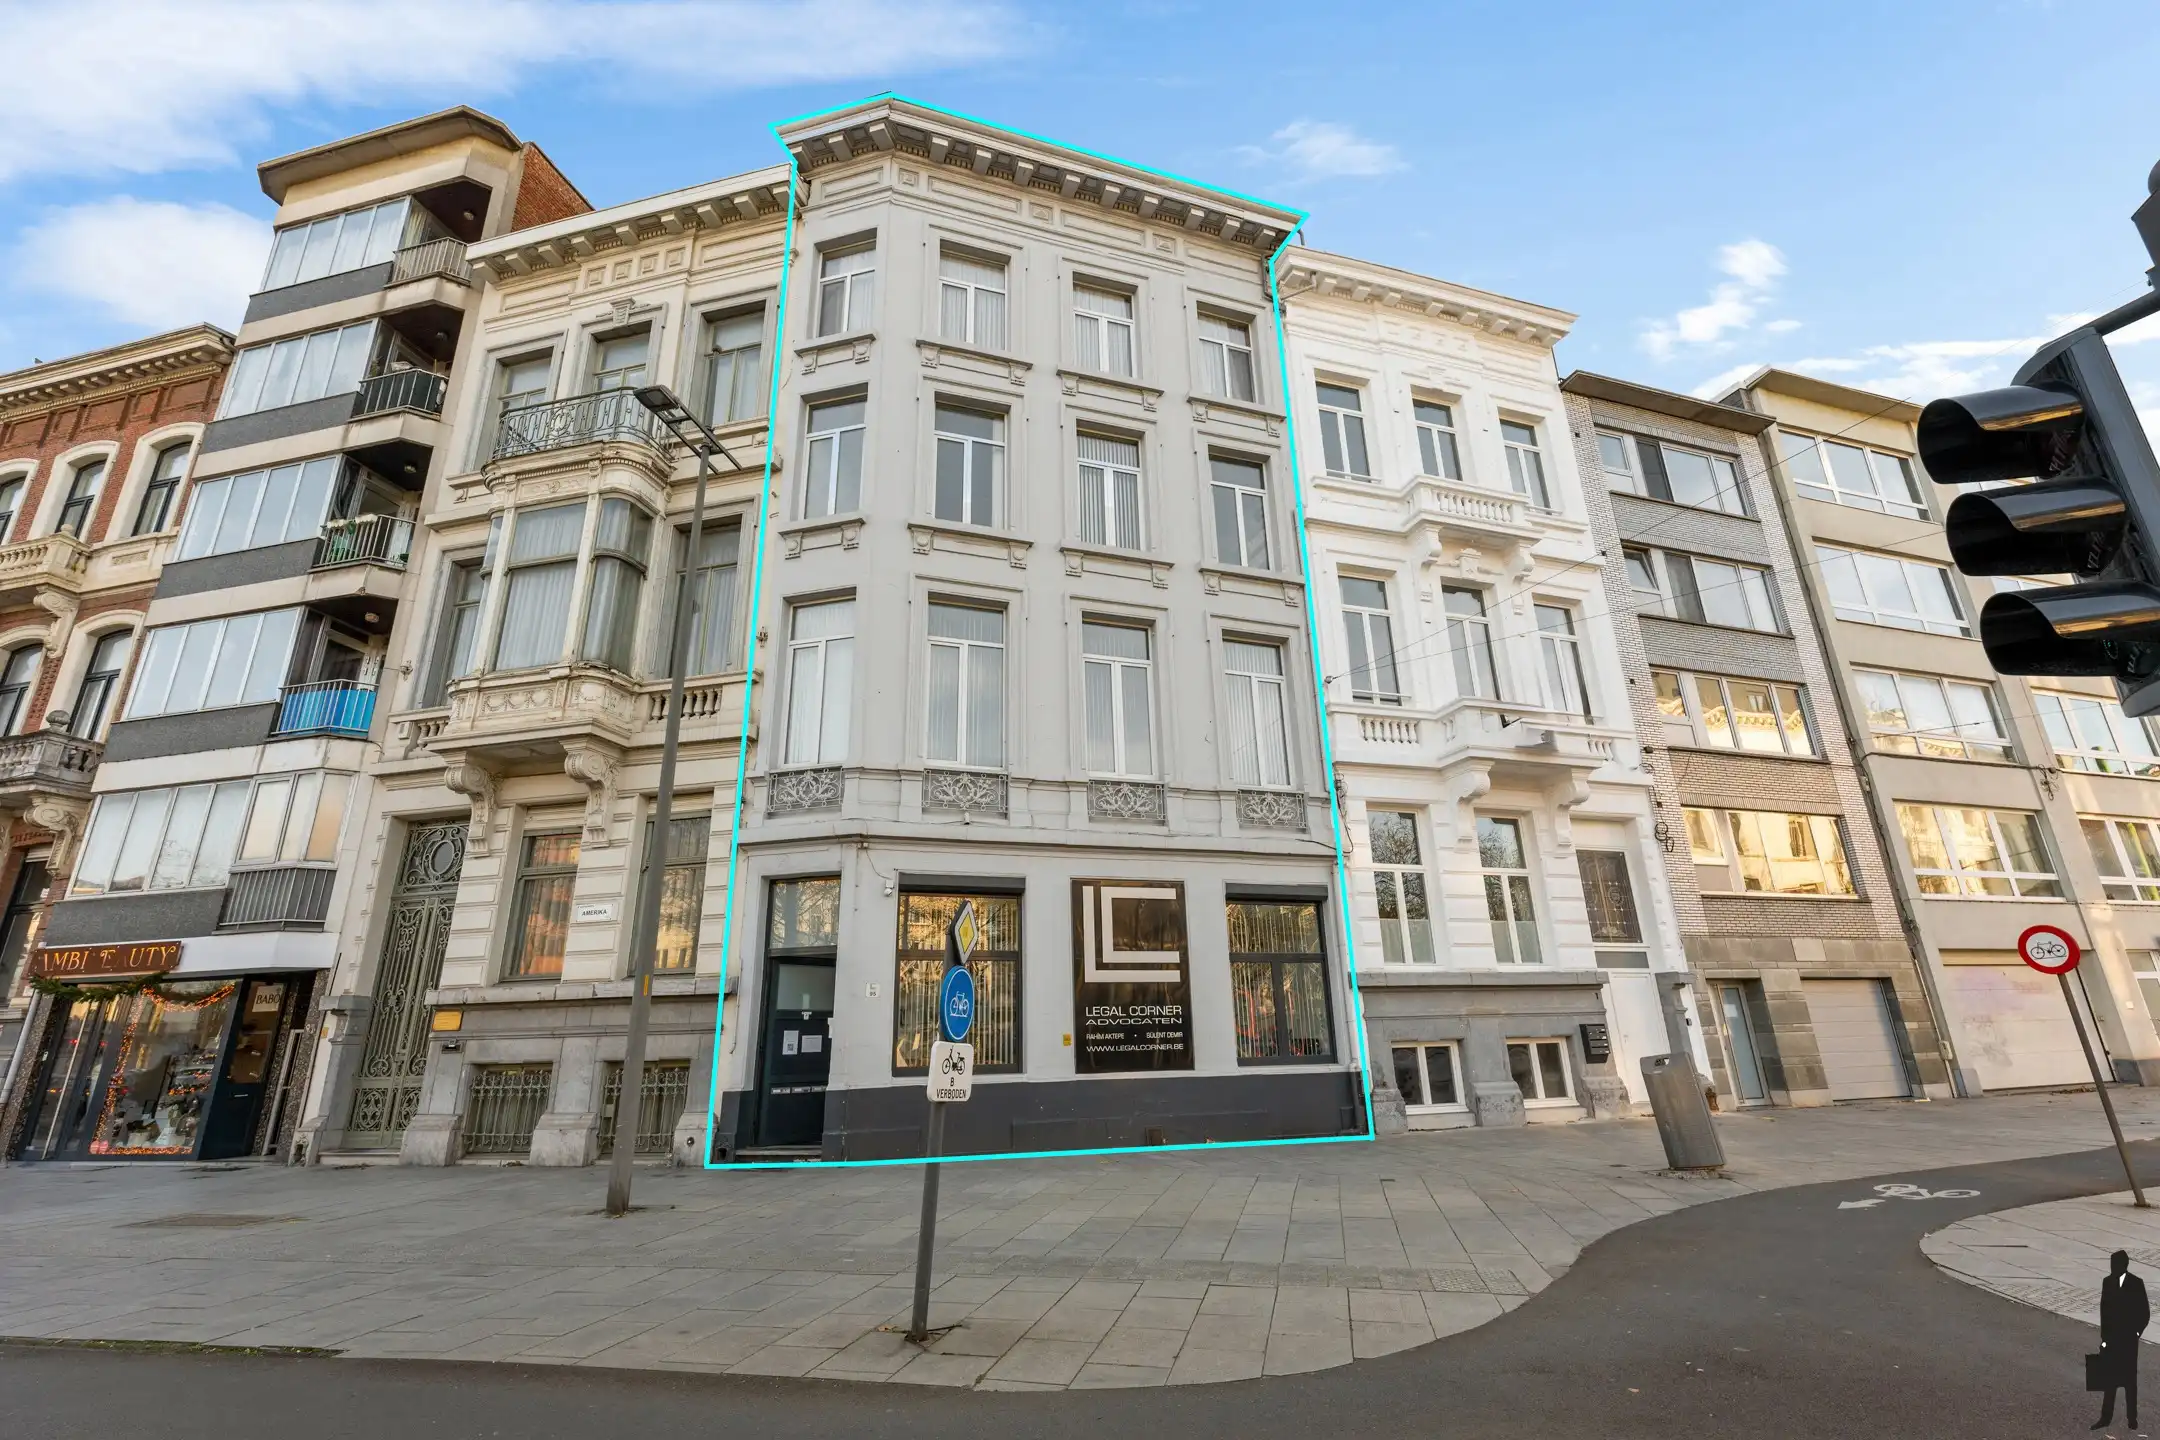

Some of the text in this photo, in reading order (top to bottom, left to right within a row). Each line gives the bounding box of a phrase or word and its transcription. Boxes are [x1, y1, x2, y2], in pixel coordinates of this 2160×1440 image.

[1085, 1005, 1182, 1017] LEGAL CORNER
[1085, 1017, 1183, 1026] ADVOCATEN
[1105, 1032, 1125, 1040] AKTEPE
[1086, 1043, 1184, 1052] WWW.LEGALCORNER.BE
[950, 1077, 955, 1087] B
[936, 1089, 967, 1099] VERBODEN
